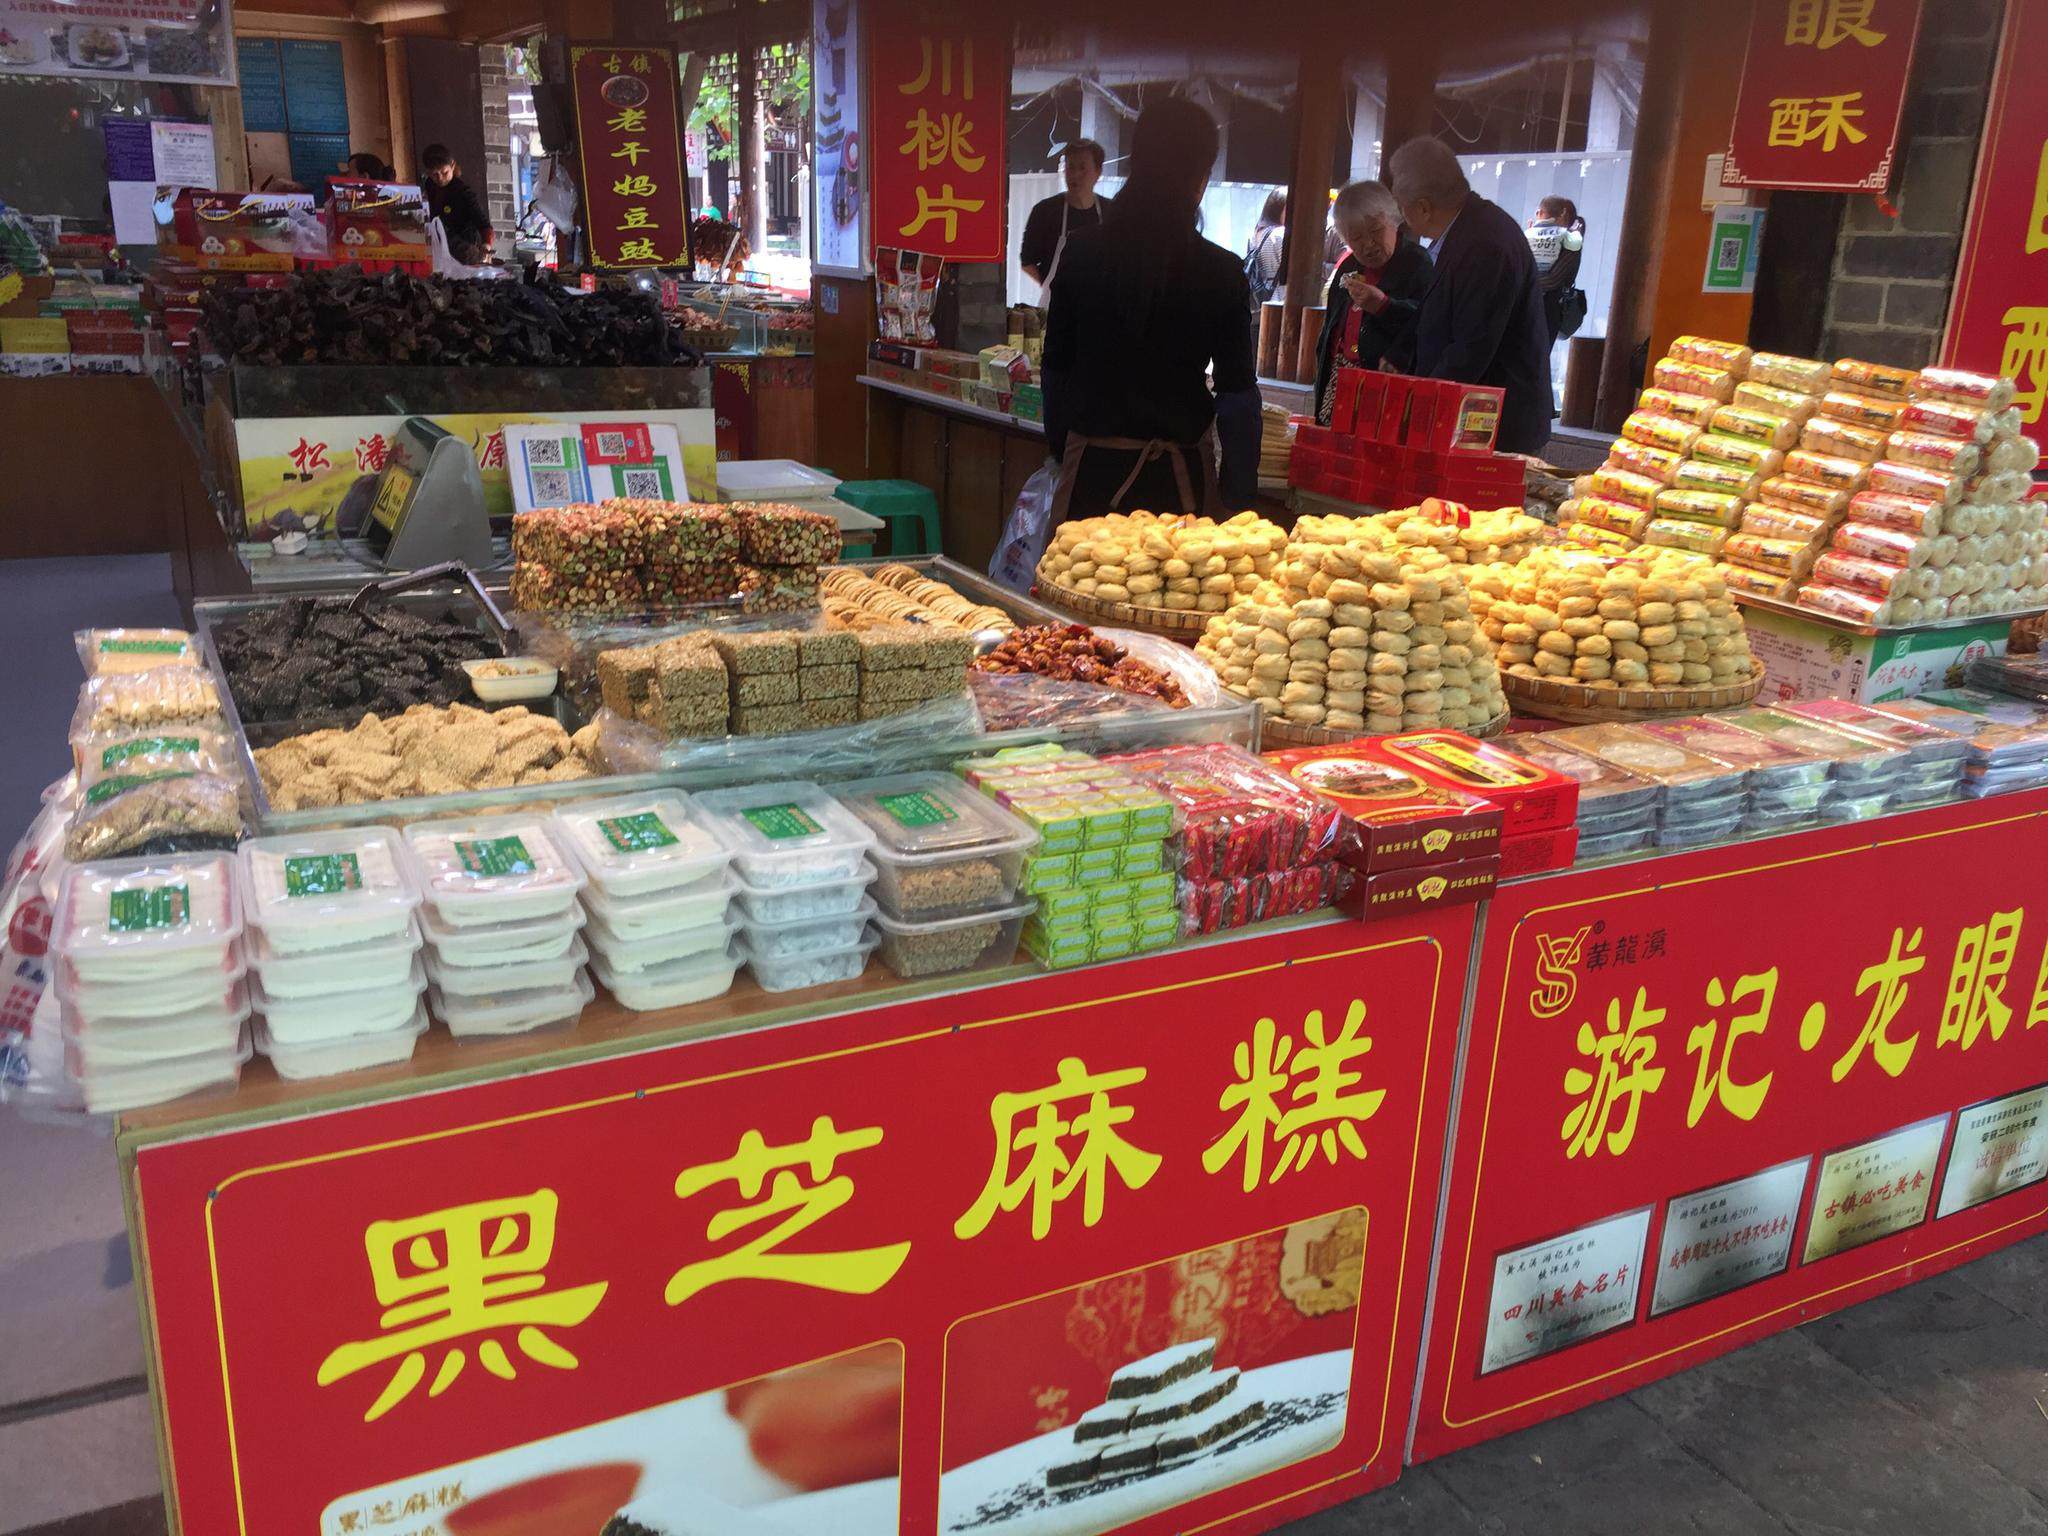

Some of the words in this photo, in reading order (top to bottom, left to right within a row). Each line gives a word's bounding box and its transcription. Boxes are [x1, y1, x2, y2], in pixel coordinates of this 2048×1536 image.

[606, 108, 664, 262] 老干妈豆豉
[898, 34, 986, 244] 川桃片
[317, 1000, 1387, 1423] 黑芝麻糕
[1503, 1264, 1629, 1321] 四川美食名片
